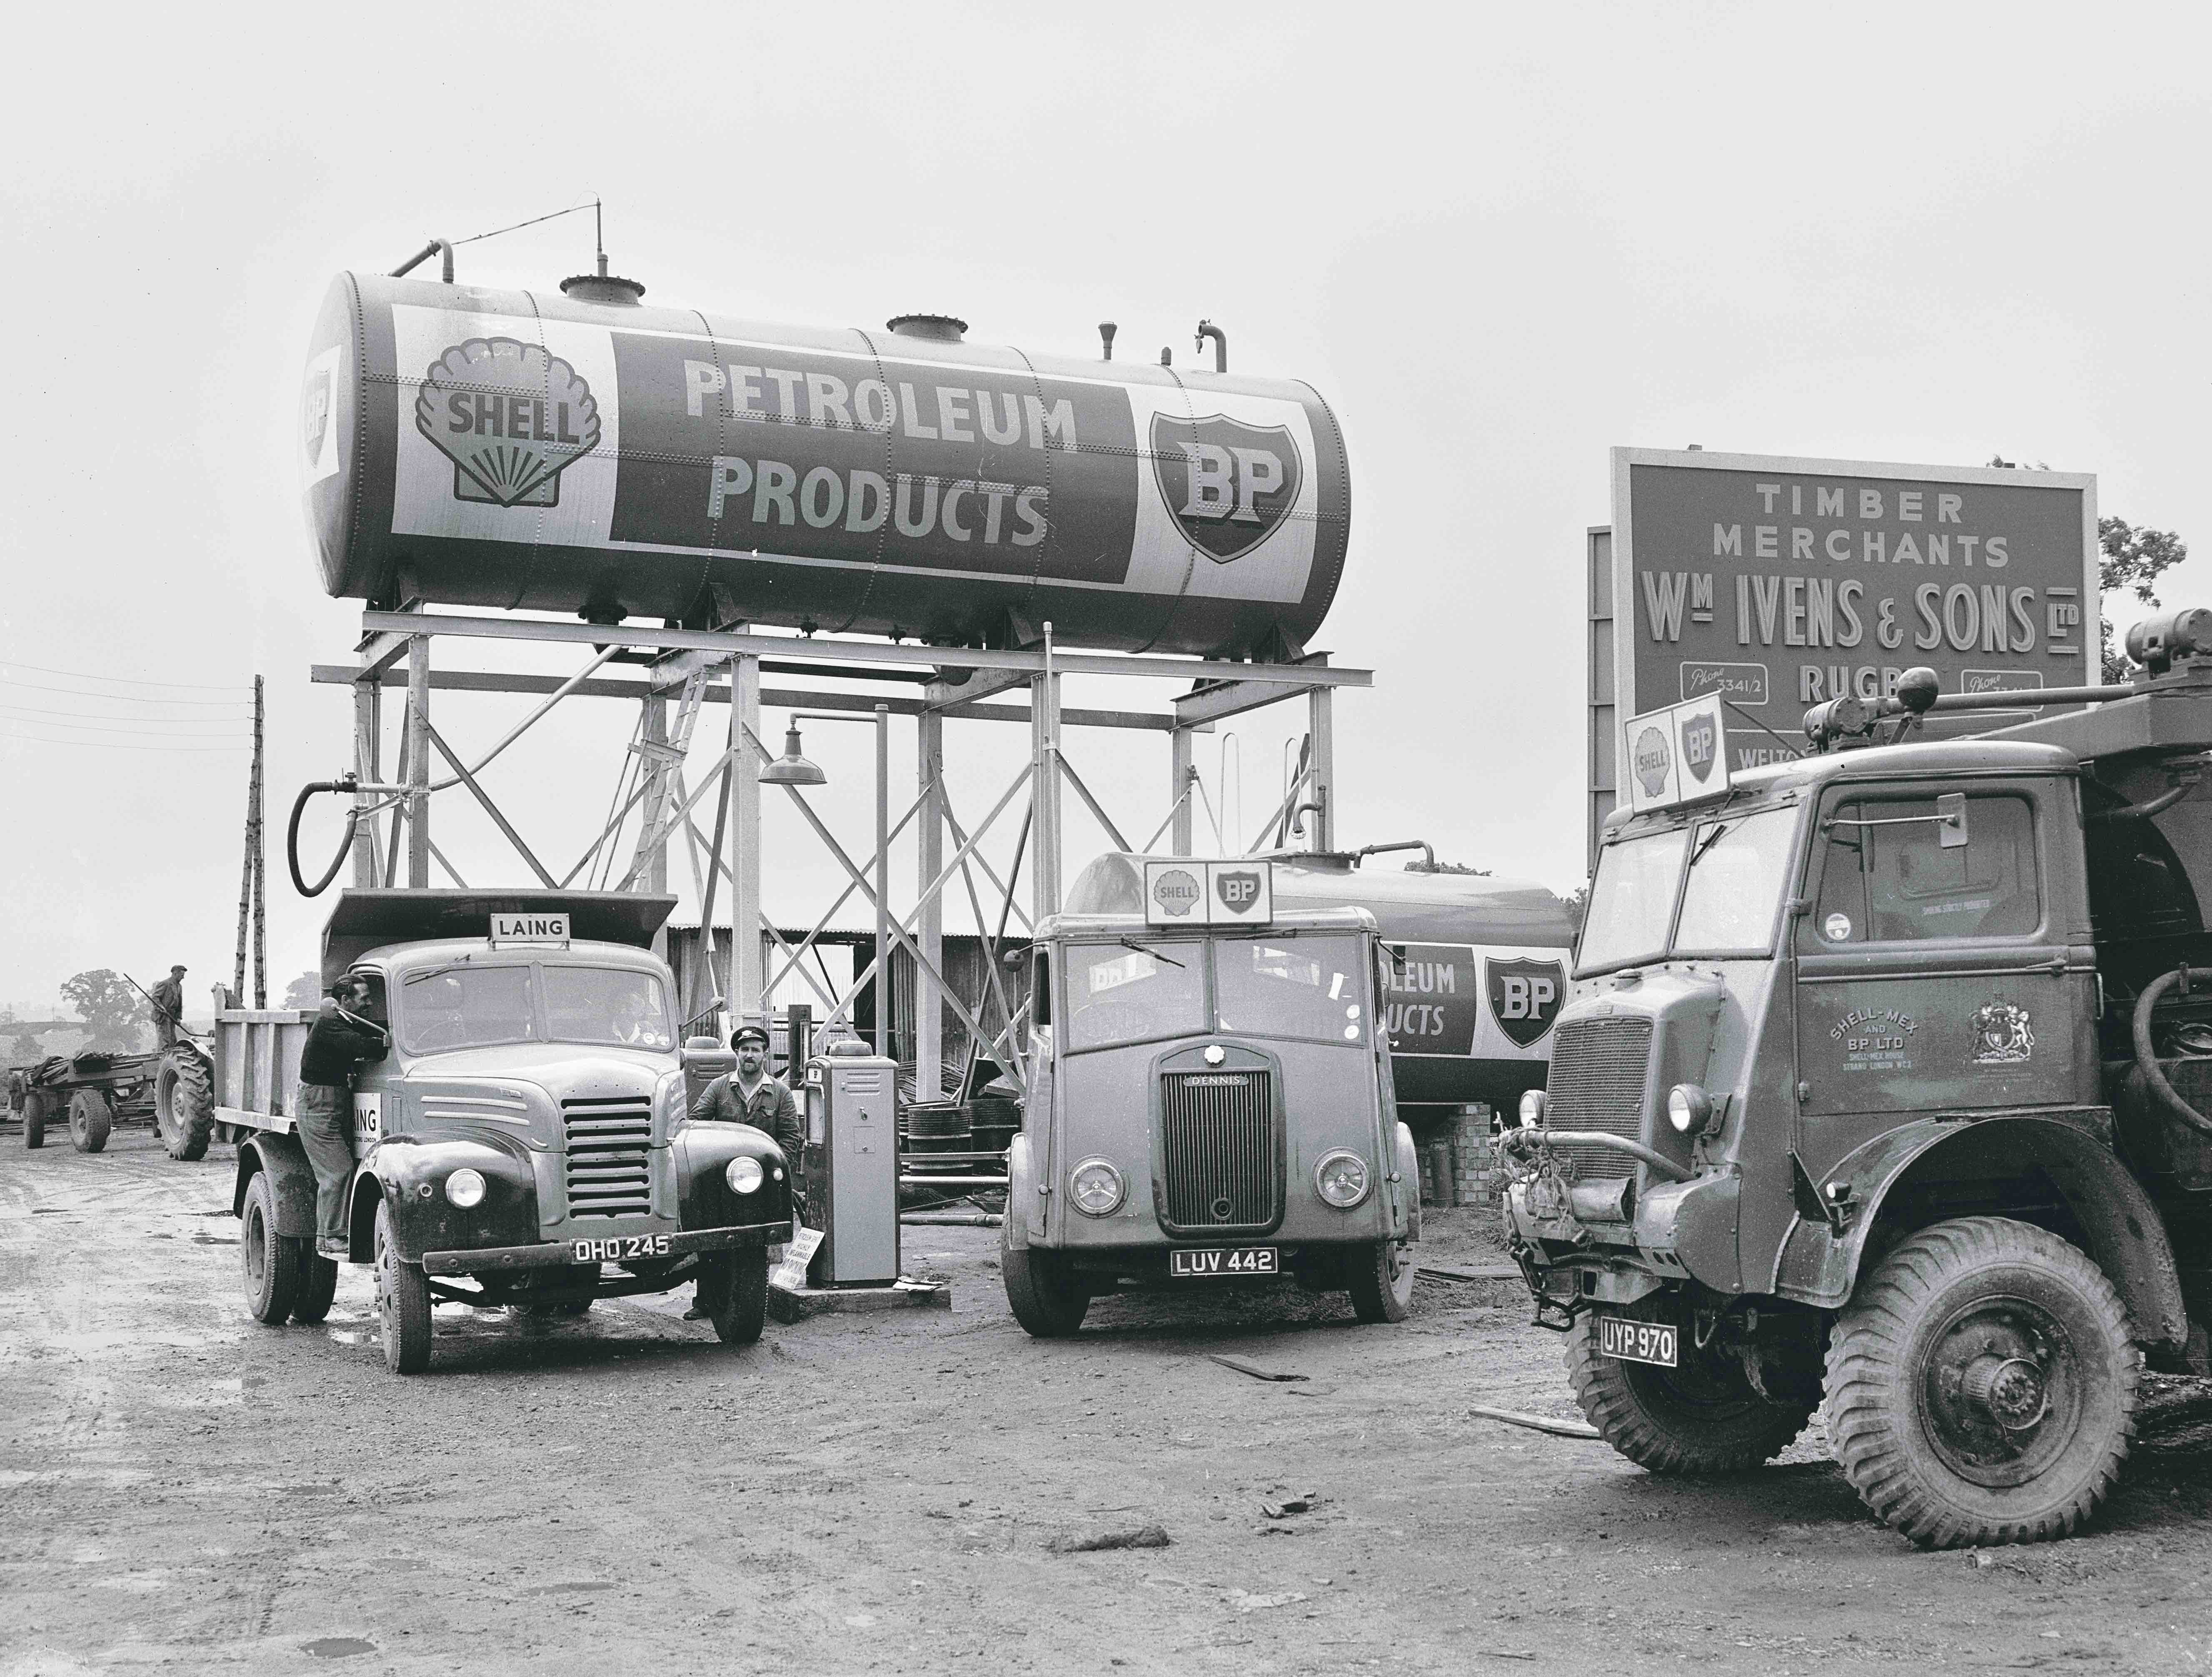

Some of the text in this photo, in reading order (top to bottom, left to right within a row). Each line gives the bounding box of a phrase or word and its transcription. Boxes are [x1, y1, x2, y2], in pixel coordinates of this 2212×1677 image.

[448, 392, 581, 444] SHELL
[684, 359, 1078, 454] PETROLEUM
[1176, 441, 1283, 522] BP
[707, 455, 1050, 546] PRODUCTS
[1756, 483, 1962, 523] TIMBER
[1714, 523, 2009, 568] MERCHANTS
[1736, 574, 1864, 648] IVENS
[1877, 597, 1904, 650] &
[1915, 582, 2035, 654] SONS
[1690, 667, 1724, 690] Phone
[1717, 674, 1762, 693] 3341/2
[1800, 665, 1902, 702] RUGB
[1970, 674, 2001, 694] Phone
[1688, 726, 1712, 766] BP
[1739, 749, 1805, 770] WELT
[1639, 750, 1666, 772] SHELL
[1160, 886, 1194, 898] SHELL
[1225, 880, 1255, 902] BP
[499, 920, 563, 936] LAING
[1379, 961, 1455, 994] OLEUM
[1500, 976, 1555, 1020] BP
[1387, 1004, 1444, 1036] UCTS
[1831, 1007, 1918, 1040] SHELL-MEX
[1865, 1025, 1886, 1033] AND
[1848, 1037, 1904, 1051] BP LTD
[1192, 1076, 1240, 1085] DENNIS
[354, 1109, 376, 1132] ING
[575, 1235, 669, 1261] OHO 245
[1176, 1251, 1272, 1273] LUV 442
[1604, 1322, 1672, 1360] UYP 970
